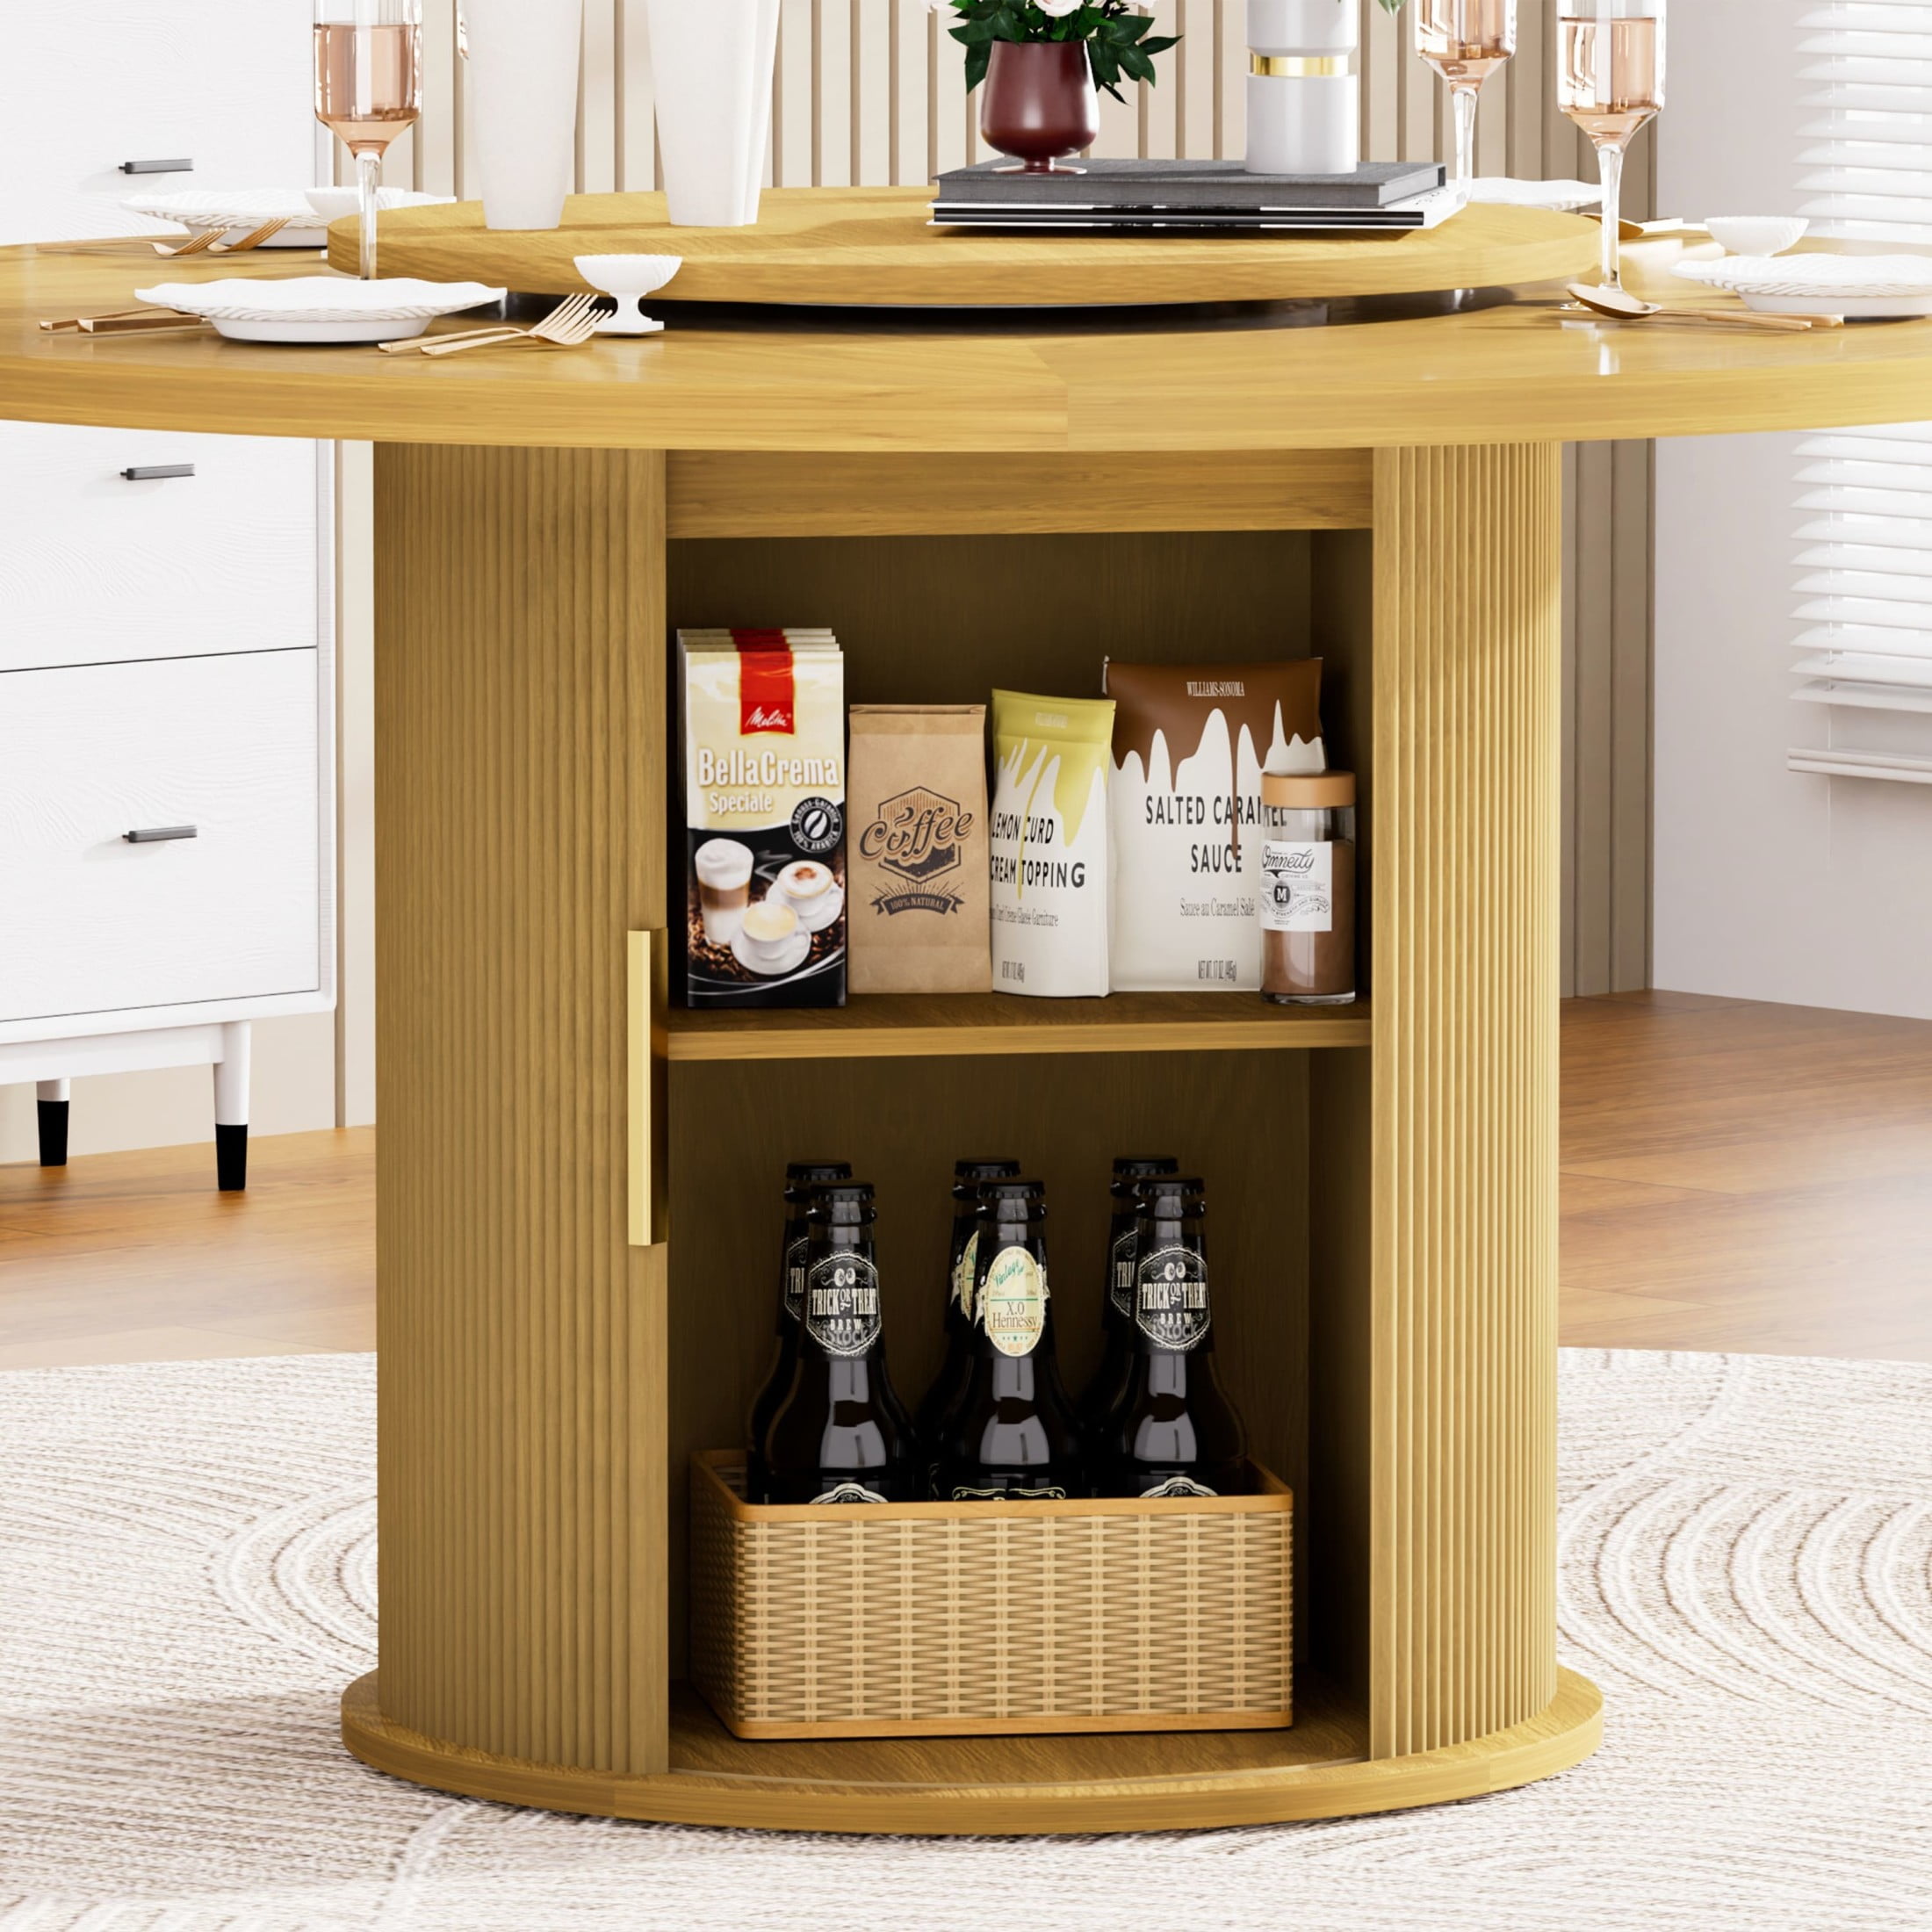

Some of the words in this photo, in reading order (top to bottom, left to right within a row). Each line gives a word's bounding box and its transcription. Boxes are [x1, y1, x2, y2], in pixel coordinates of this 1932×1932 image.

[710, 793, 773, 816] Speciale
[1146, 796, 1205, 825] SALTED
[860, 806, 973, 860] Coffee
[991, 812, 1021, 840] LEMON
[1024, 816, 1054, 844] CURD
[990, 854, 1017, 884] CREAM
[1021, 860, 1085, 889] TOPPING
[1191, 844, 1242, 873] SAUCE
[911, 897, 945, 910] NATURAL
[812, 1288, 840, 1316] TRICK
[852, 1288, 876, 1315] TREAT
[1142, 1283, 1170, 1309] TRICK
[1181, 1283, 1207, 1308] TREAT
[830, 1318, 861, 1330] BREW
[991, 1312, 1039, 1329] Hennessy
[1160, 1313, 1192, 1324] BREW
